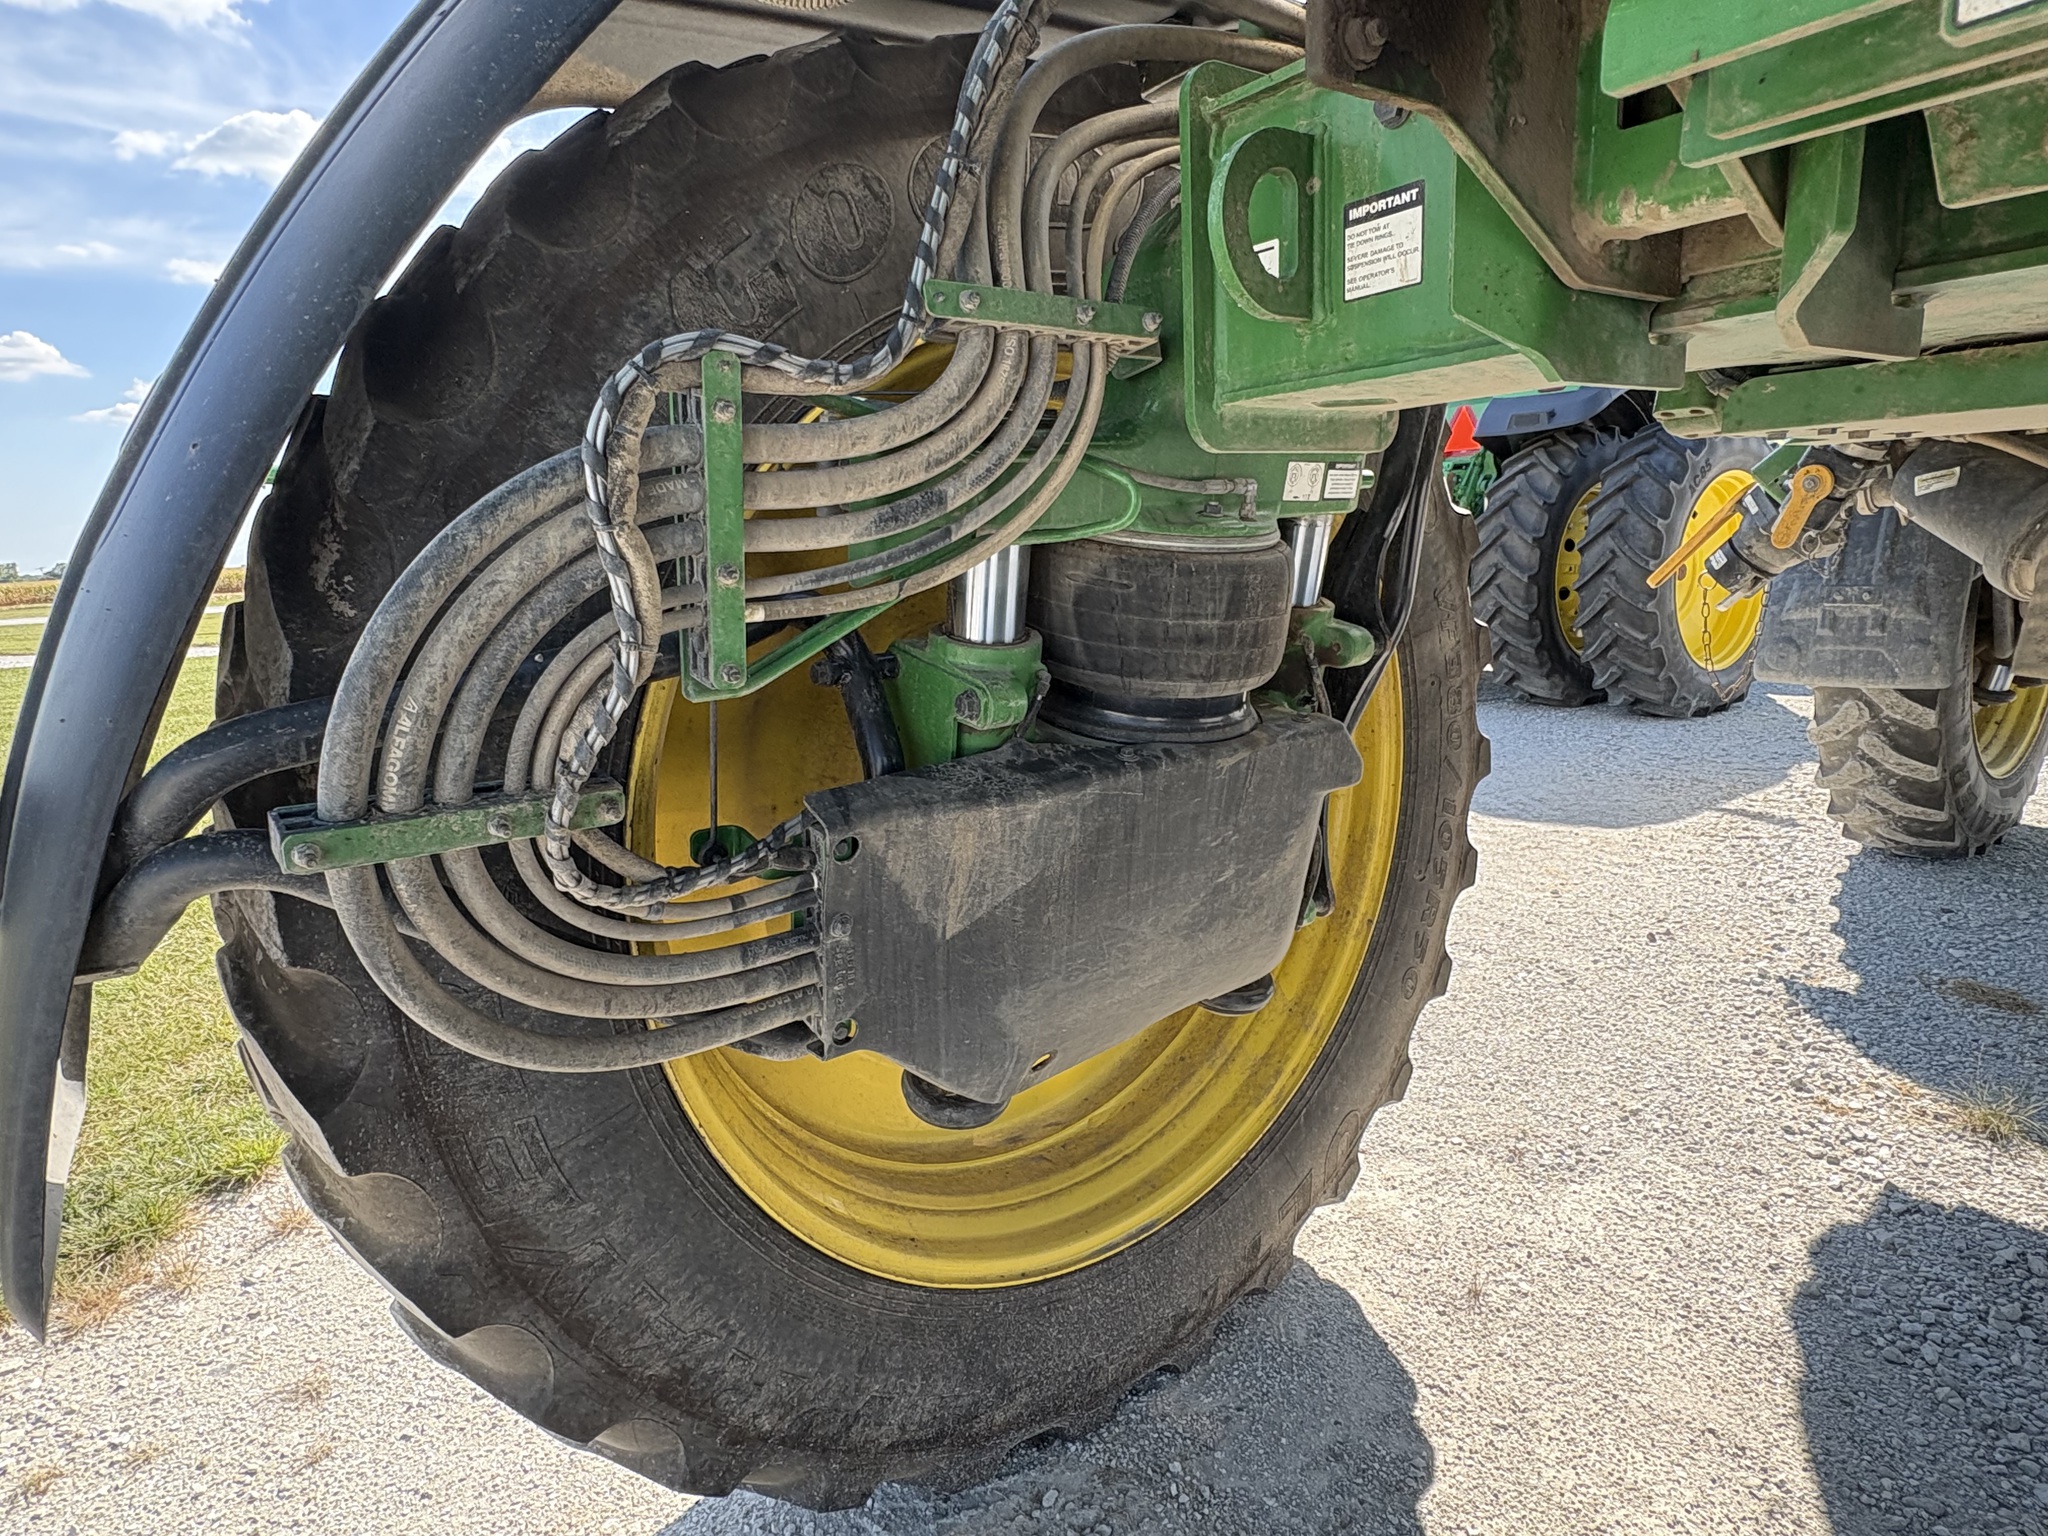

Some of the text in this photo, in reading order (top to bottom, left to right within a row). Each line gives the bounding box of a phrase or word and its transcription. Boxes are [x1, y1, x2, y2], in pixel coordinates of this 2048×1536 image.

[1349, 187, 1420, 221] IMPORTANT
[1356, 229, 1368, 239] NOT
[1369, 225, 1381, 236] TOW
[1382, 222, 1390, 231] AT
[1347, 242, 1355, 250] TIE
[1356, 237, 1374, 247] DOWN
[1347, 241, 1404, 263] SEVERE DAMAGE TO
[1347, 257, 1382, 272] SUSPENSION
[1383, 252, 1397, 263] WILL
[1347, 277, 1357, 286] SEE
[1357, 267, 1395, 282] OPERATOR'S
